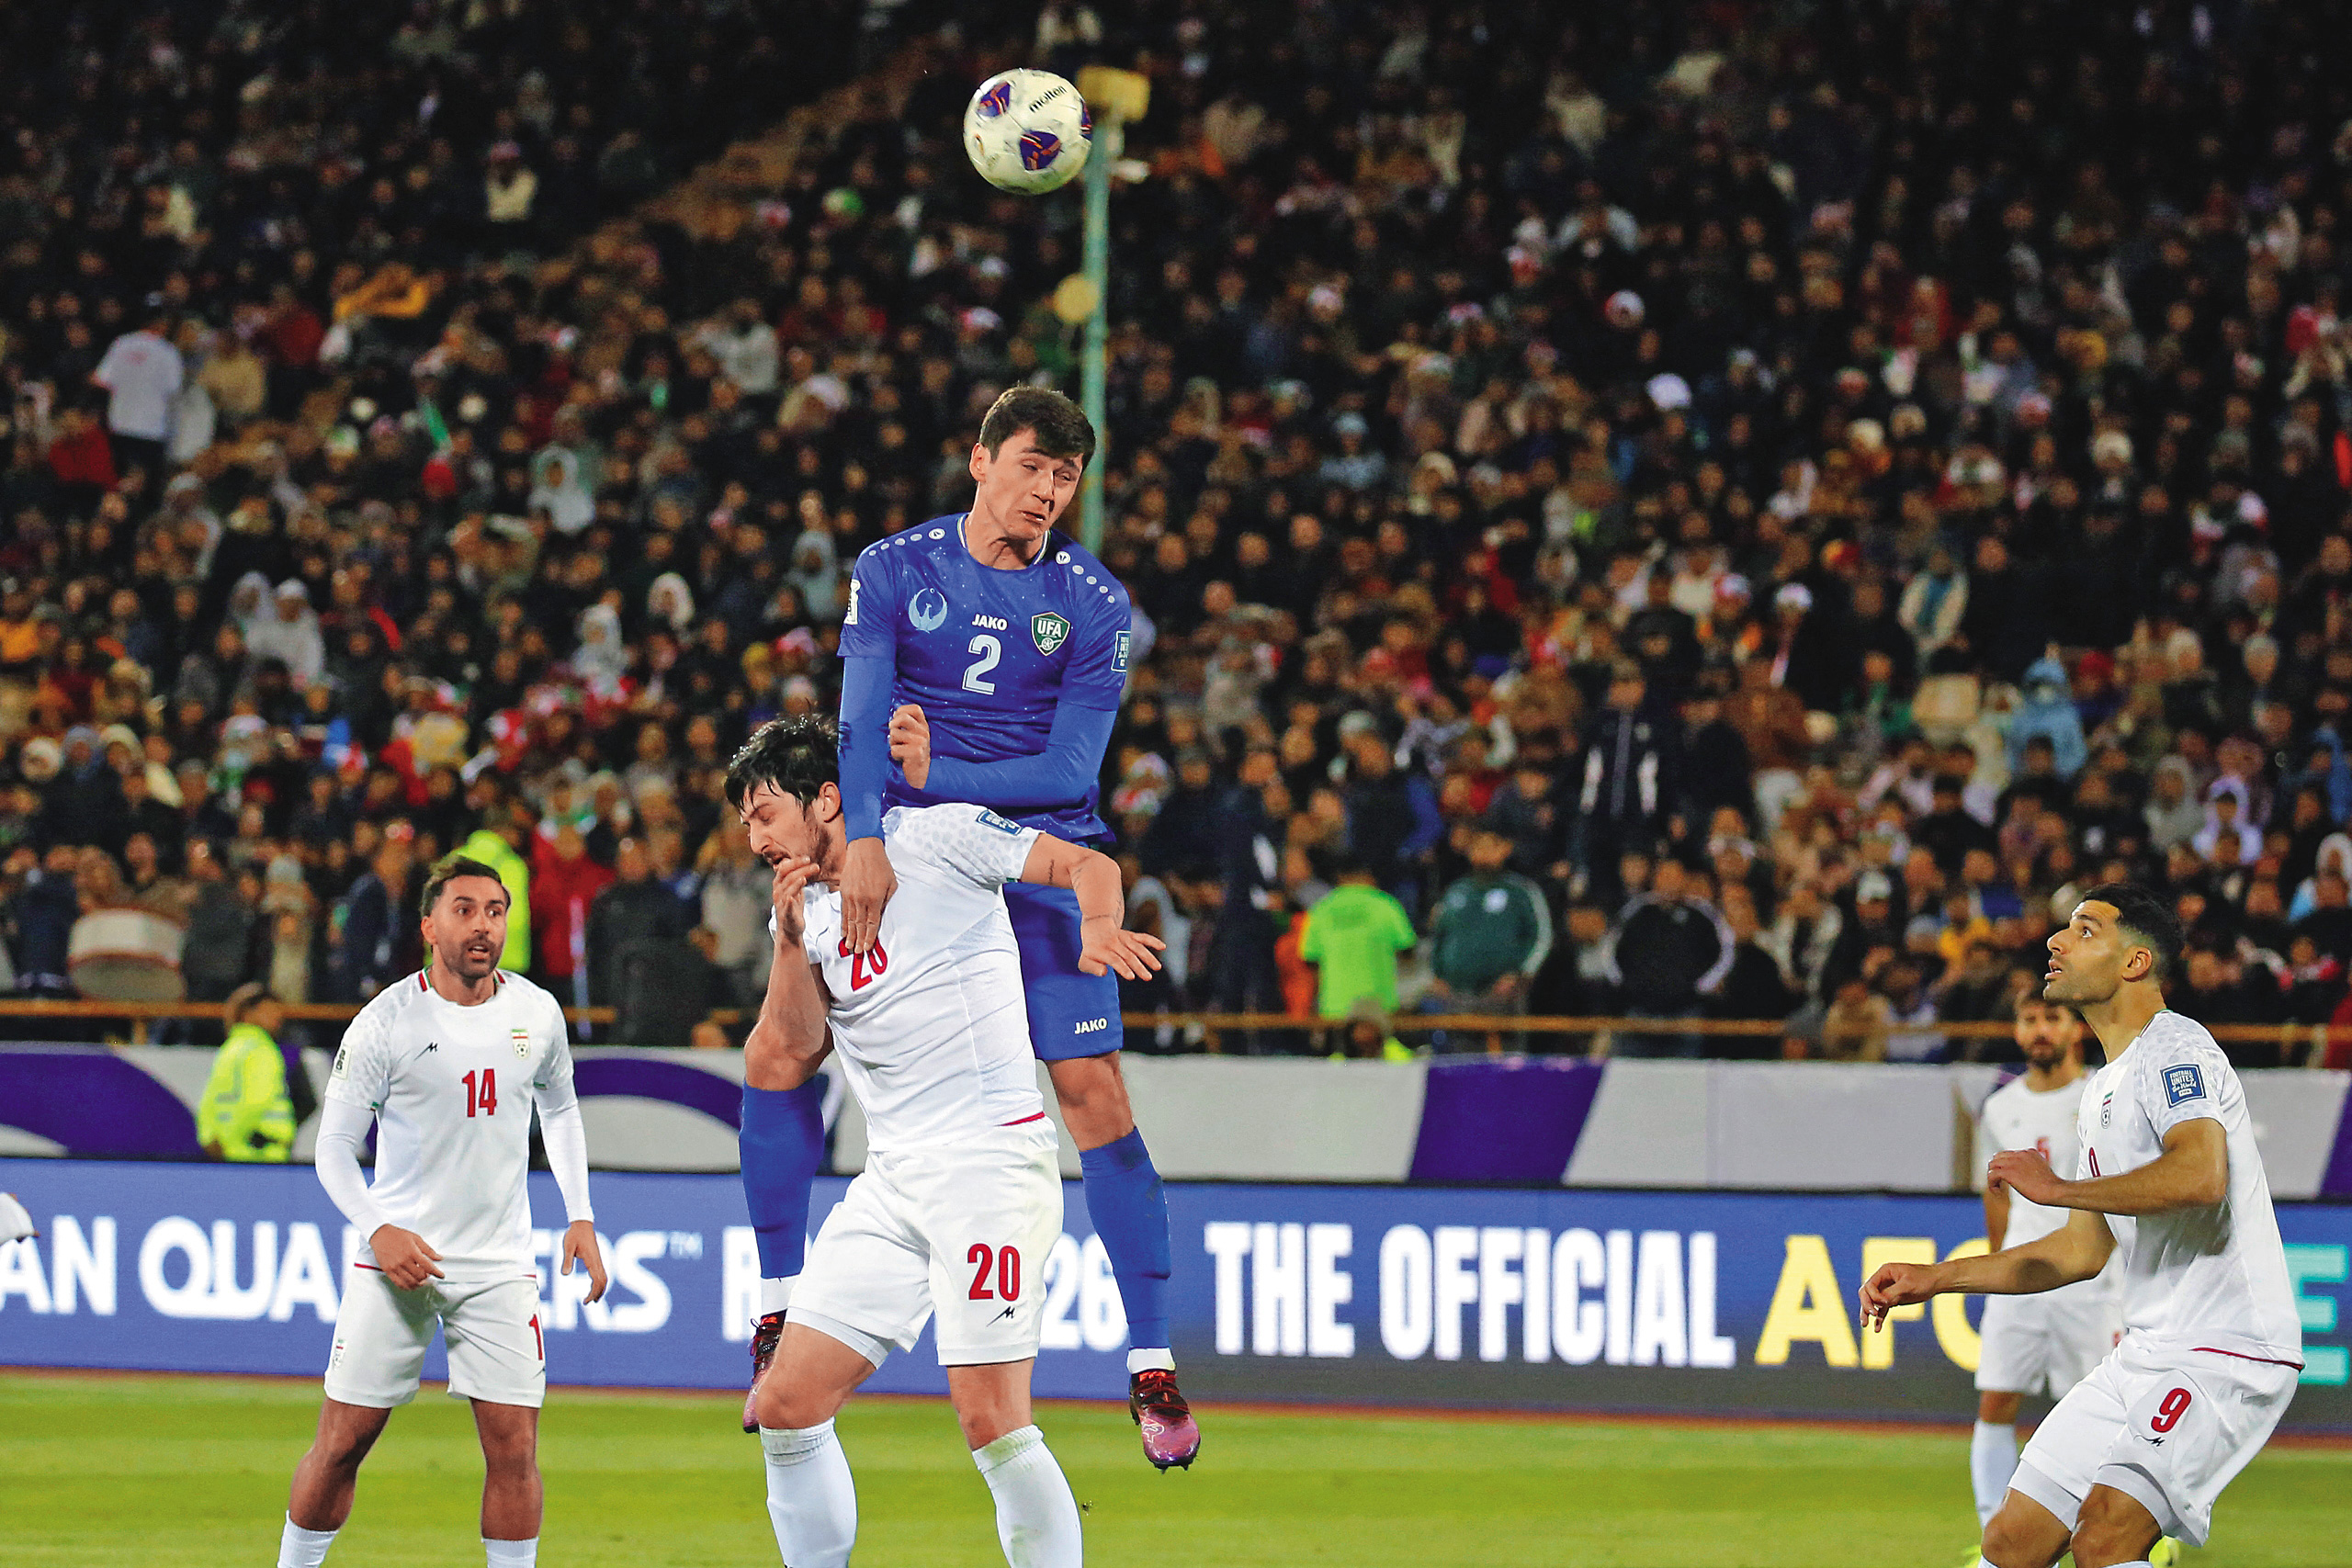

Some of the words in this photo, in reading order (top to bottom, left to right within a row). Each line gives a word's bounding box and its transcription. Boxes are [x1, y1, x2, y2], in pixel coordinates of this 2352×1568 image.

[1028, 85, 1068, 113] molten
[972, 614, 1008, 631] JAKO
[1036, 619, 1062, 637] UFA
[962, 634, 1001, 695] 2
[1074, 1017, 1108, 1034] JAKO
[462, 1068, 497, 1117] 14
[2171, 1076, 2195, 1085] UNITES
[967, 1243, 1021, 1302] 20
[1204, 1221, 1356, 1358] THE
[1378, 1224, 1736, 1369] OFFICIAL
[2150, 1387, 2192, 1433] 9
